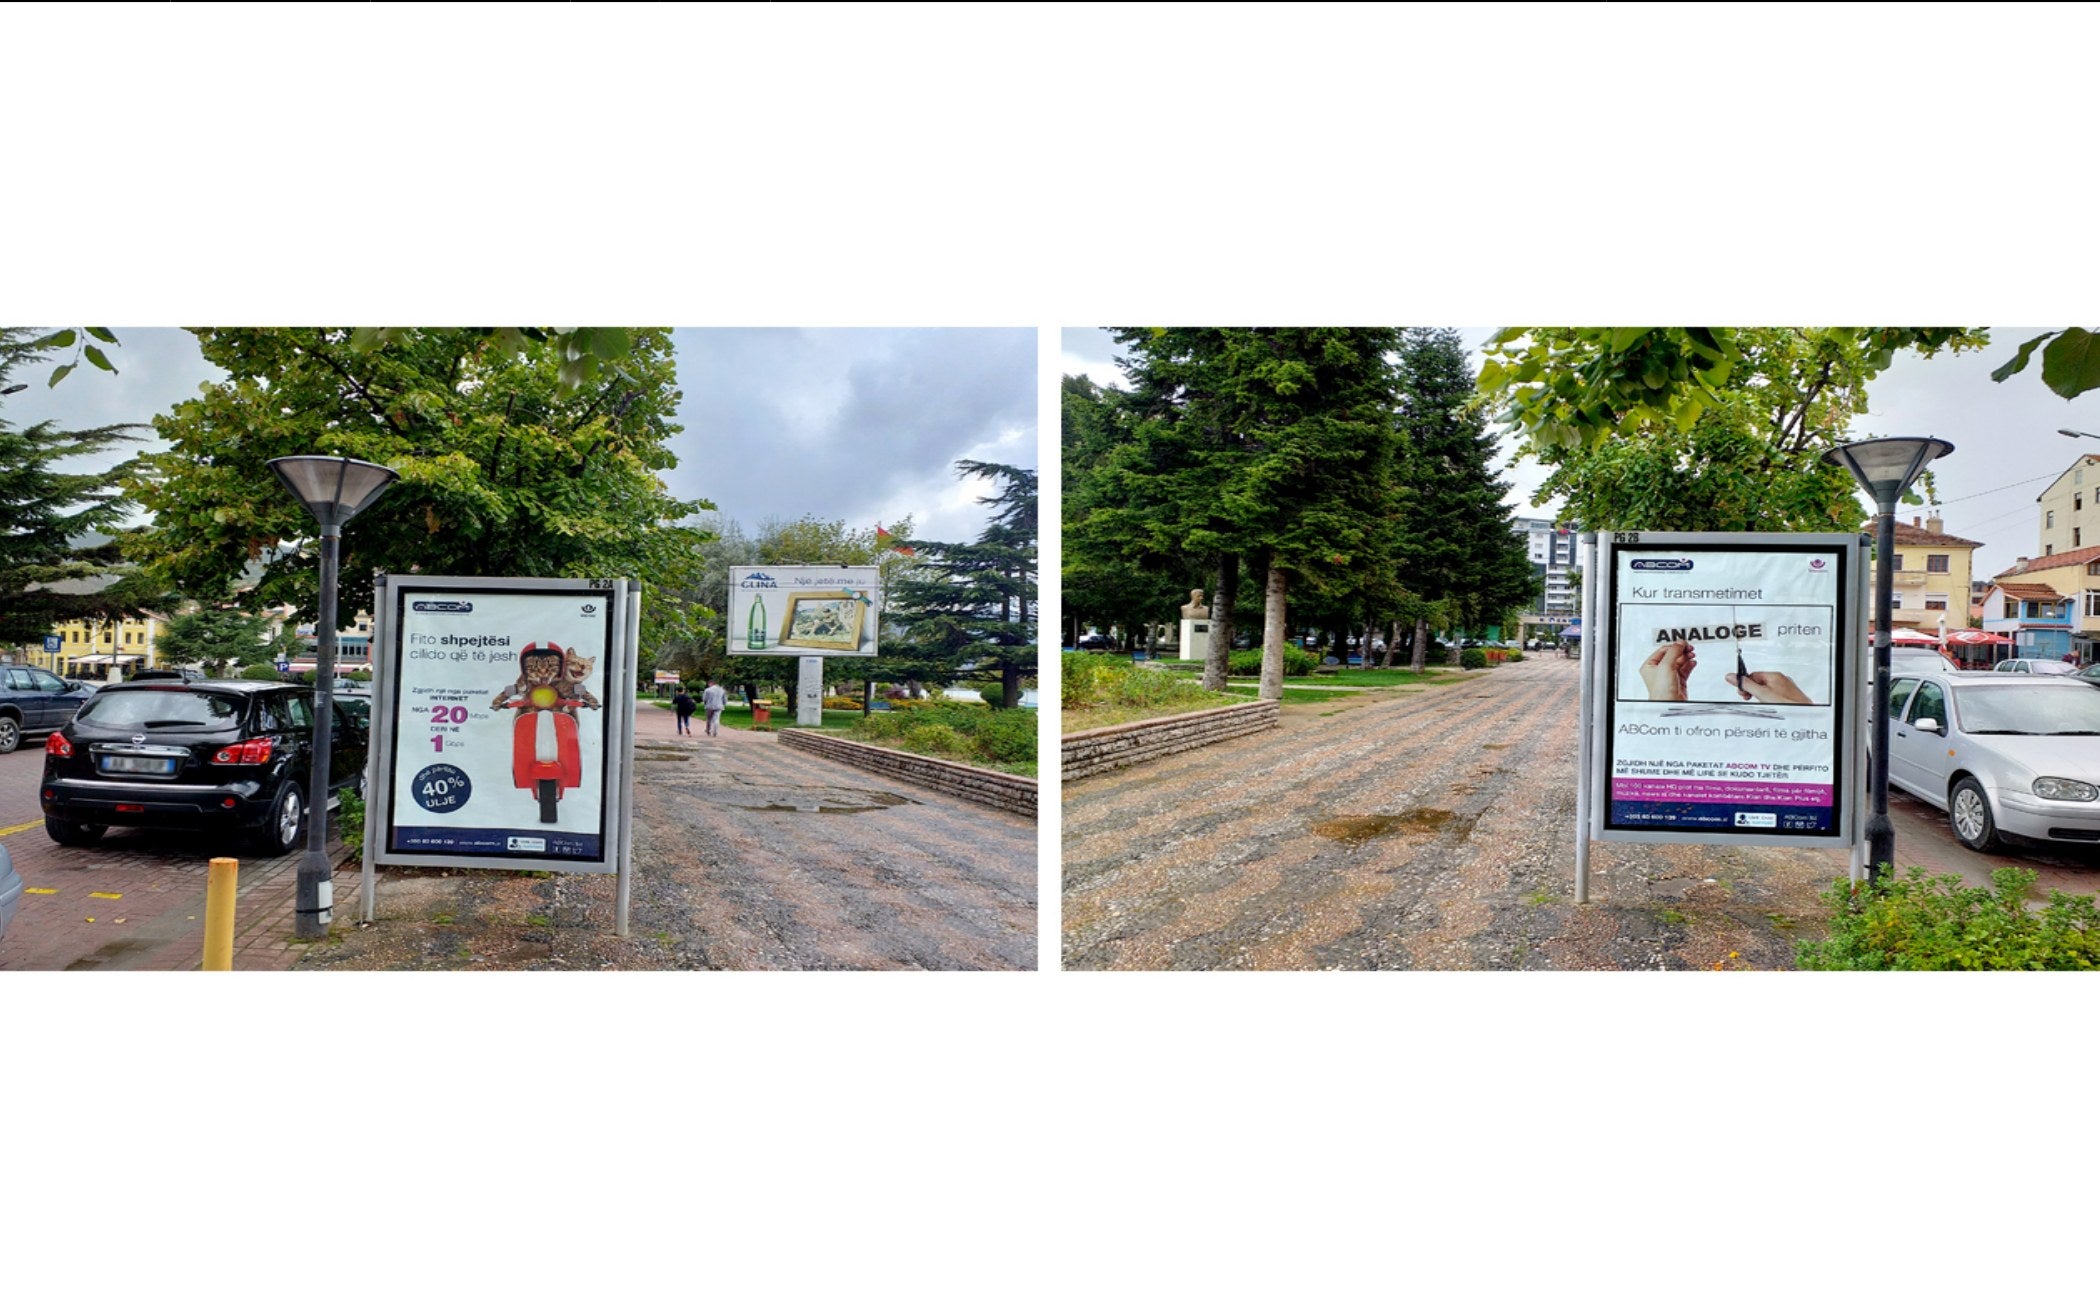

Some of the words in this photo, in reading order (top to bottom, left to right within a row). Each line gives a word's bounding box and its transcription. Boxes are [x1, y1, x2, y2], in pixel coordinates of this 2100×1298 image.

[1614, 533, 1626, 542] PG
[589, 579, 601, 589] PG
[603, 579, 614, 589] 2A
[1632, 586, 1658, 599] Kur
[1663, 587, 1763, 600] transmetimet
[410, 633, 437, 645] Fito
[440, 634, 510, 648] shpejtësi
[1656, 624, 1763, 643] ANALOGE
[1777, 623, 1822, 638] priten
[410, 648, 447, 660] cilido
[450, 649, 469, 663] që
[472, 650, 487, 661] të
[489, 650, 519, 663] jesh
[431, 705, 468, 724] 20
[1618, 723, 1671, 736] ABCom
[1674, 724, 1683, 736] ti
[1686, 725, 1721, 737] ofron
[1724, 726, 1771, 740] përsëri
[1774, 728, 1788, 739] të
[1791, 728, 1828, 741] gjitha
[431, 735, 443, 752] 1
[422, 776, 465, 796] 40%
[426, 795, 457, 807] ULJE
